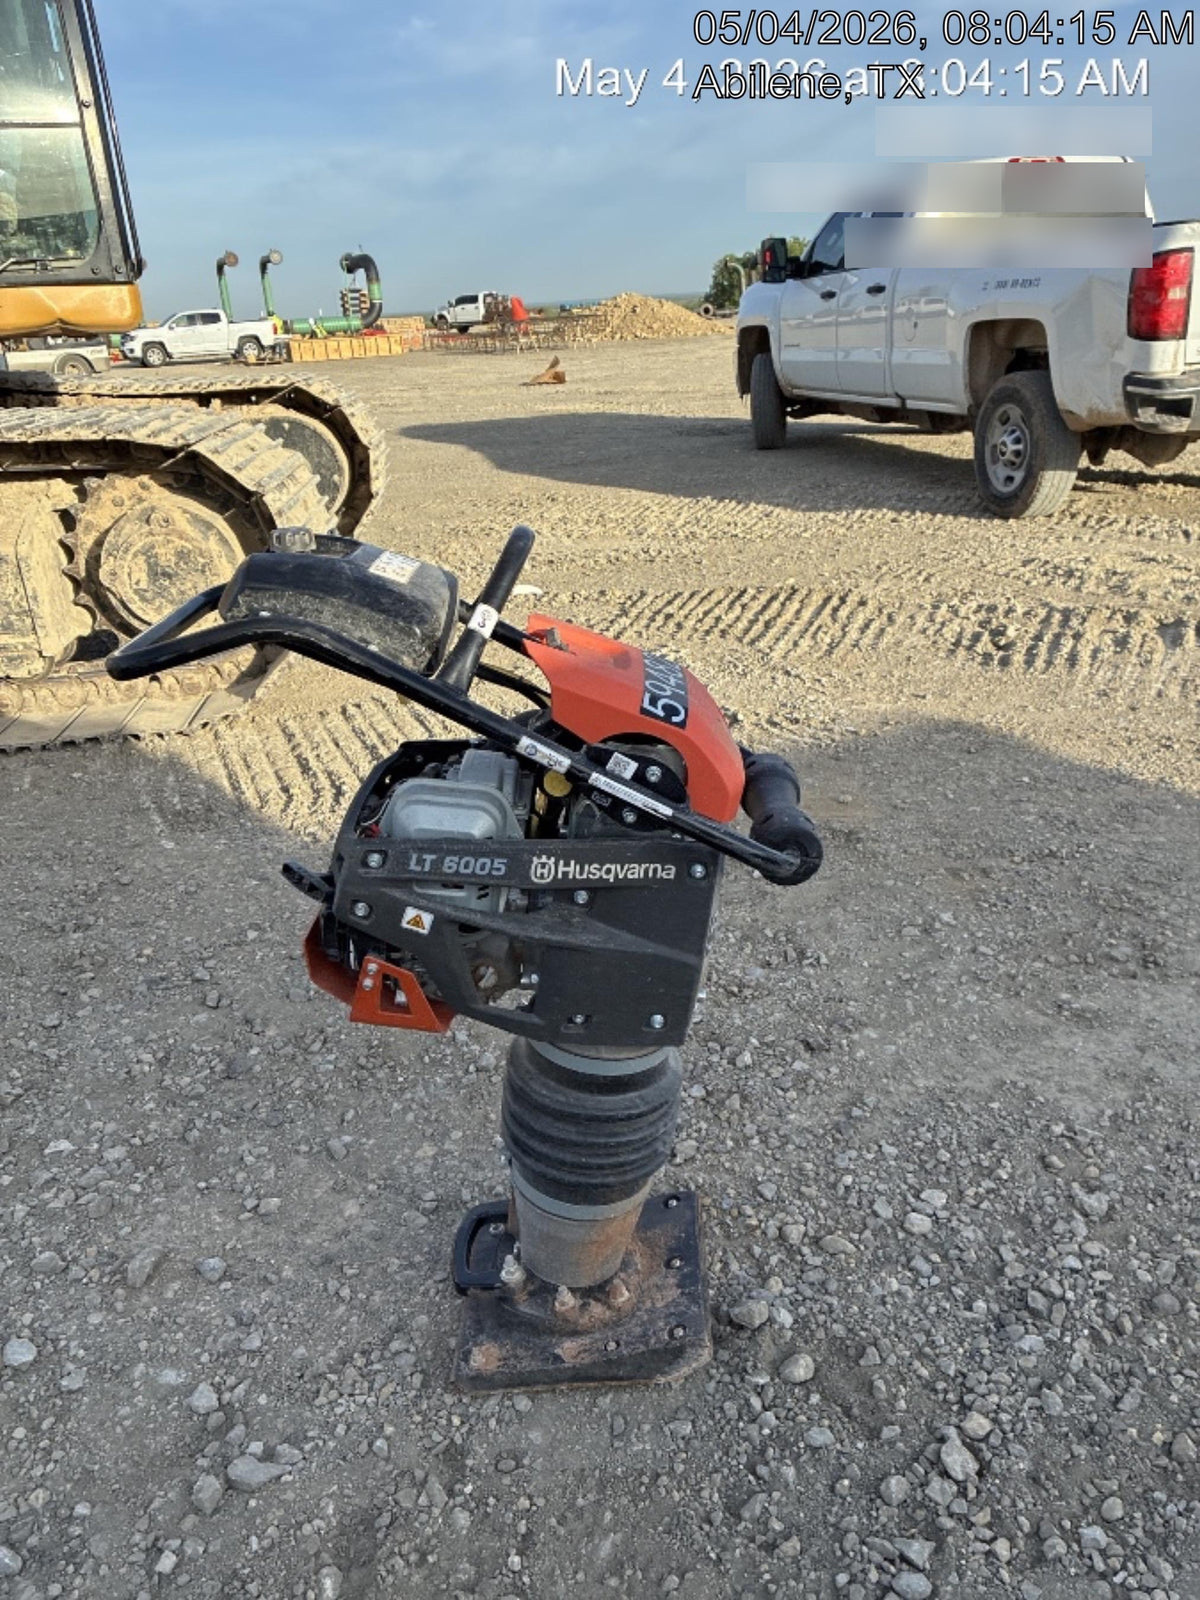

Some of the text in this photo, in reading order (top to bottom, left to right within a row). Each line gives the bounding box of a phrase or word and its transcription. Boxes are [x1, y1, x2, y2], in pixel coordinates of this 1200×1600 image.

[409, 853, 508, 877] LT 6005
[557, 859, 677, 882] Husqvarna
